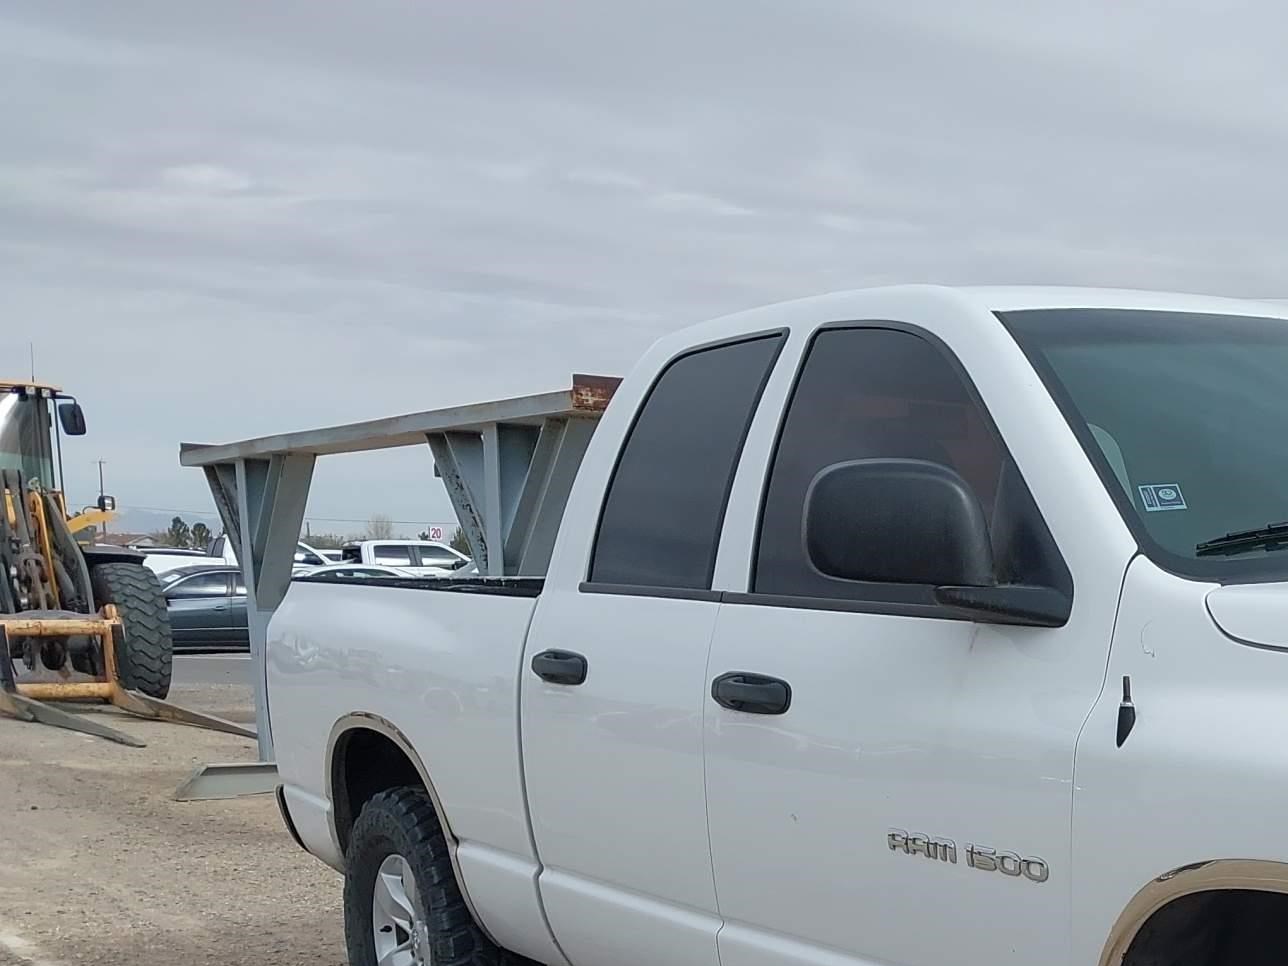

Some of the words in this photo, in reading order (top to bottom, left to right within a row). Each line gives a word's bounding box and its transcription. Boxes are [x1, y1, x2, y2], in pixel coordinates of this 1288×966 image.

[431, 527, 442, 539] 20
[887, 827, 957, 864] RAM
[965, 842, 1049, 883] 1500
